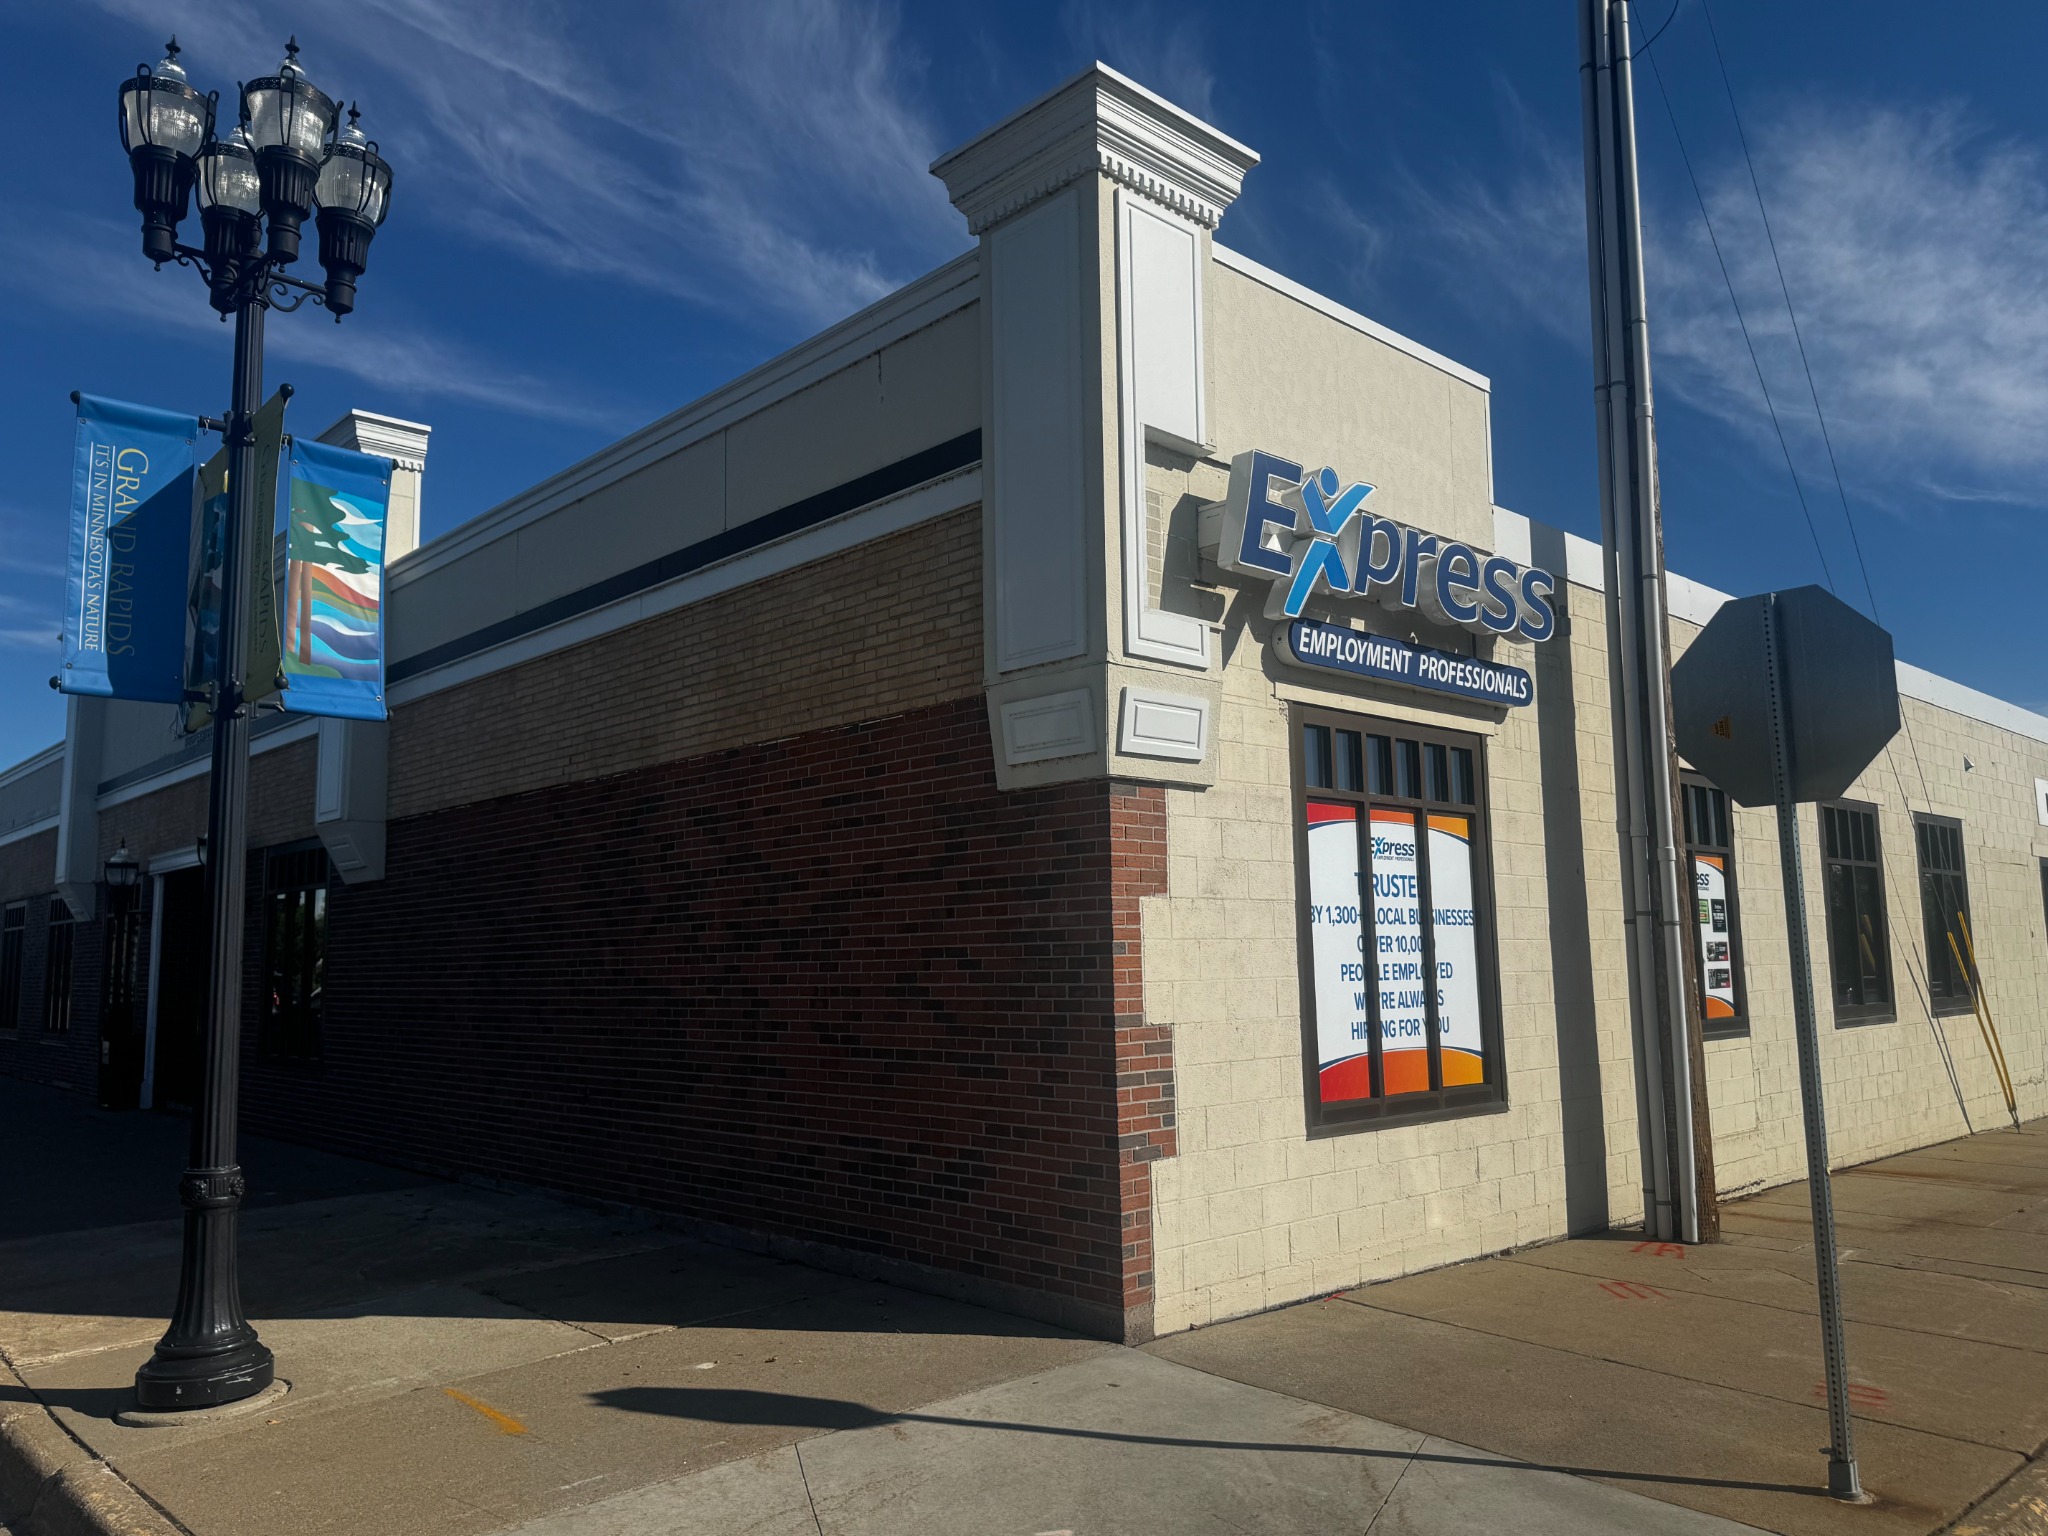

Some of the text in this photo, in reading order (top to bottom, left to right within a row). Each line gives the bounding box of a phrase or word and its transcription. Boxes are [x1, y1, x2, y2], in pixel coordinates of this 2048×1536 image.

[84, 443, 110, 651] IT'S IN MINNESOTA'S NATURE
[107, 447, 149, 657] GRAND RAPIDS
[1238, 449, 1556, 643] Express
[1299, 626, 1527, 699] EMPLOYMENT PROFESSIONALS
[1354, 872, 1423, 898] TRUSTE
[1395, 935, 1435, 955] 10,00
[1340, 963, 1390, 981] PEOLE
[1397, 989, 1445, 1009] ALWAS
[1351, 1020, 1396, 1040] HIRNG
[1399, 1018, 1421, 1037] FOR
